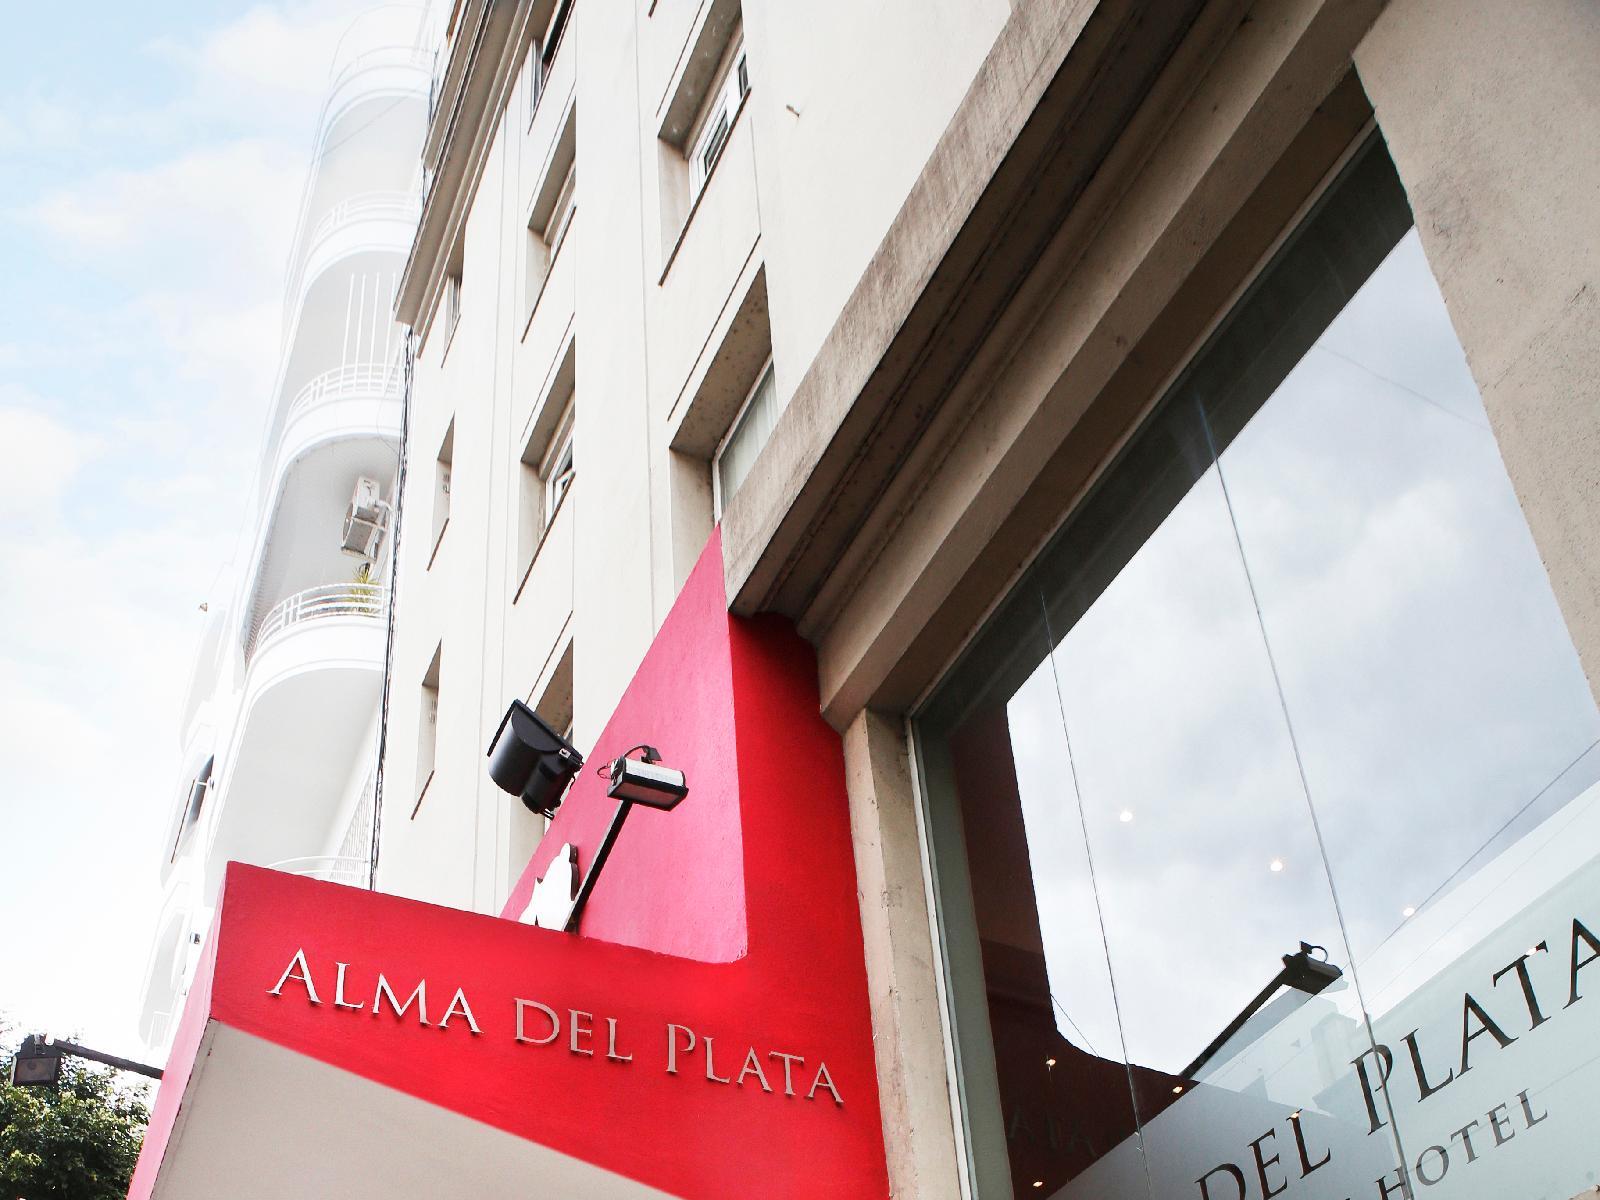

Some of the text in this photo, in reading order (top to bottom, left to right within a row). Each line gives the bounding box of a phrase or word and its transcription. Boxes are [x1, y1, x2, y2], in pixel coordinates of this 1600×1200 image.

[265, 946, 845, 1104] ALMA DEL PLATA
[1350, 917, 1600, 1136] PLATA
